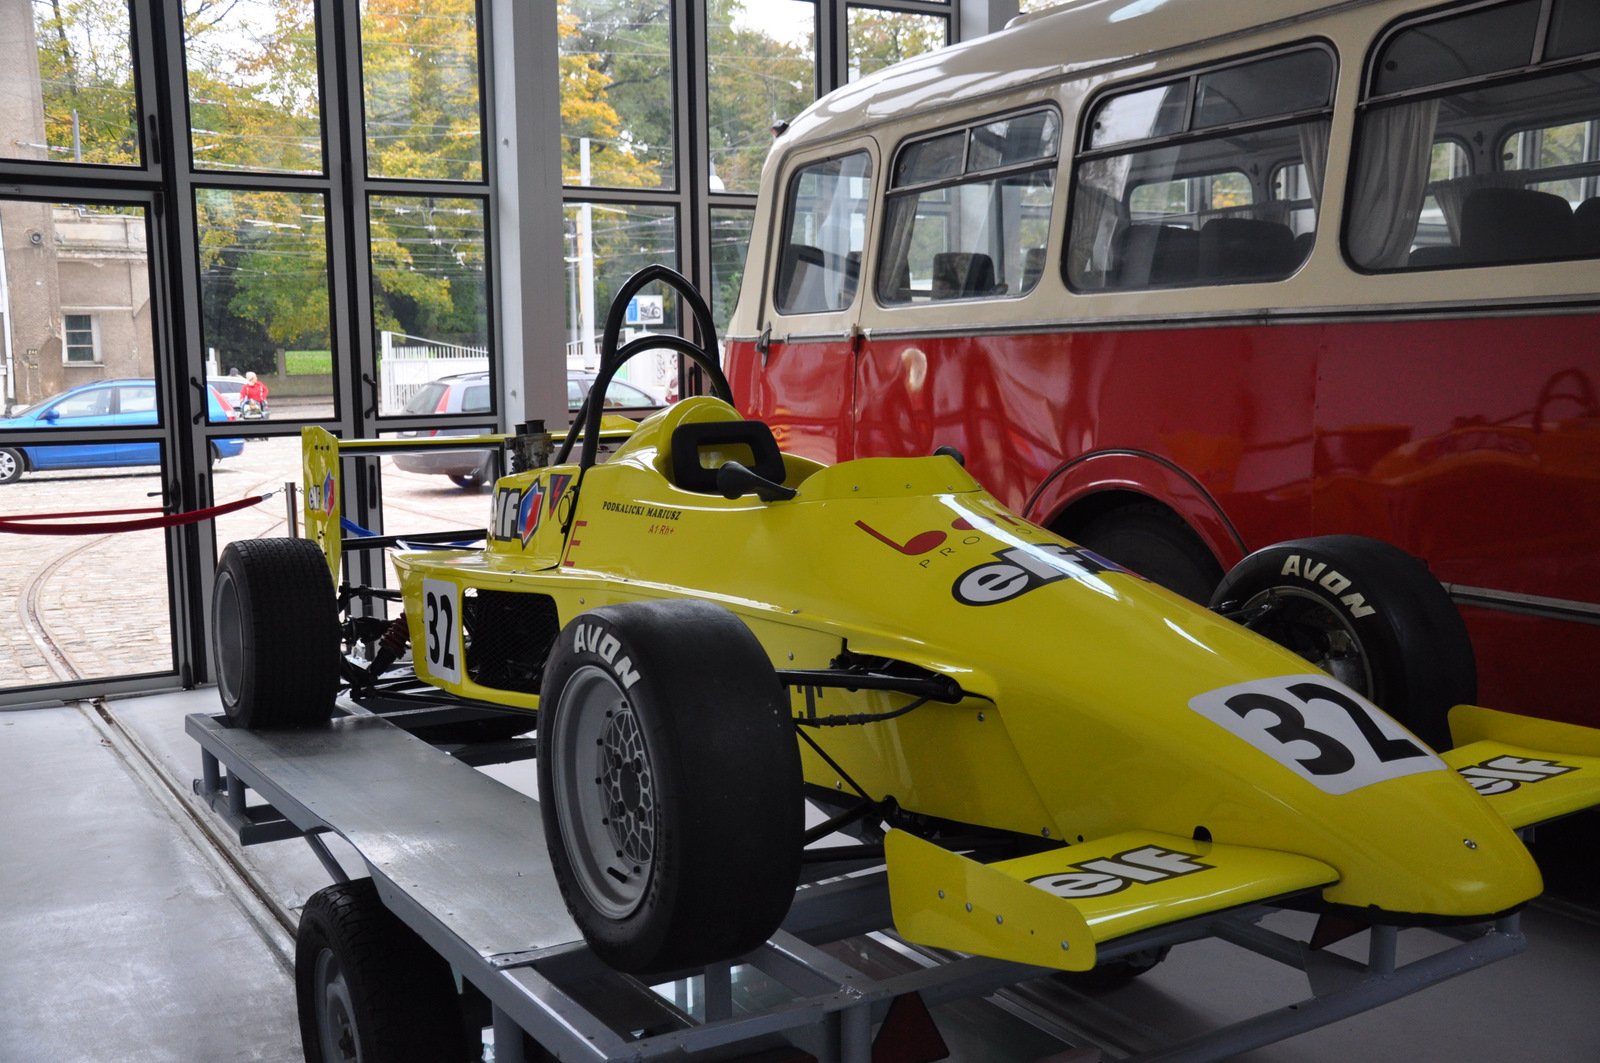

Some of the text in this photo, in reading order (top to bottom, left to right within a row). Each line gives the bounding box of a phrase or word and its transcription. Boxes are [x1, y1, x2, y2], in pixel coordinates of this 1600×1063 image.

[602, 501, 682, 521] PODKALICKI MARIUSZ
[951, 543, 1101, 607] elf
[1281, 554, 1376, 619] AVON
[427, 591, 455, 671] 32
[573, 623, 641, 689] AVON
[1224, 682, 1429, 776] 32
[1024, 844, 1217, 899] elf
